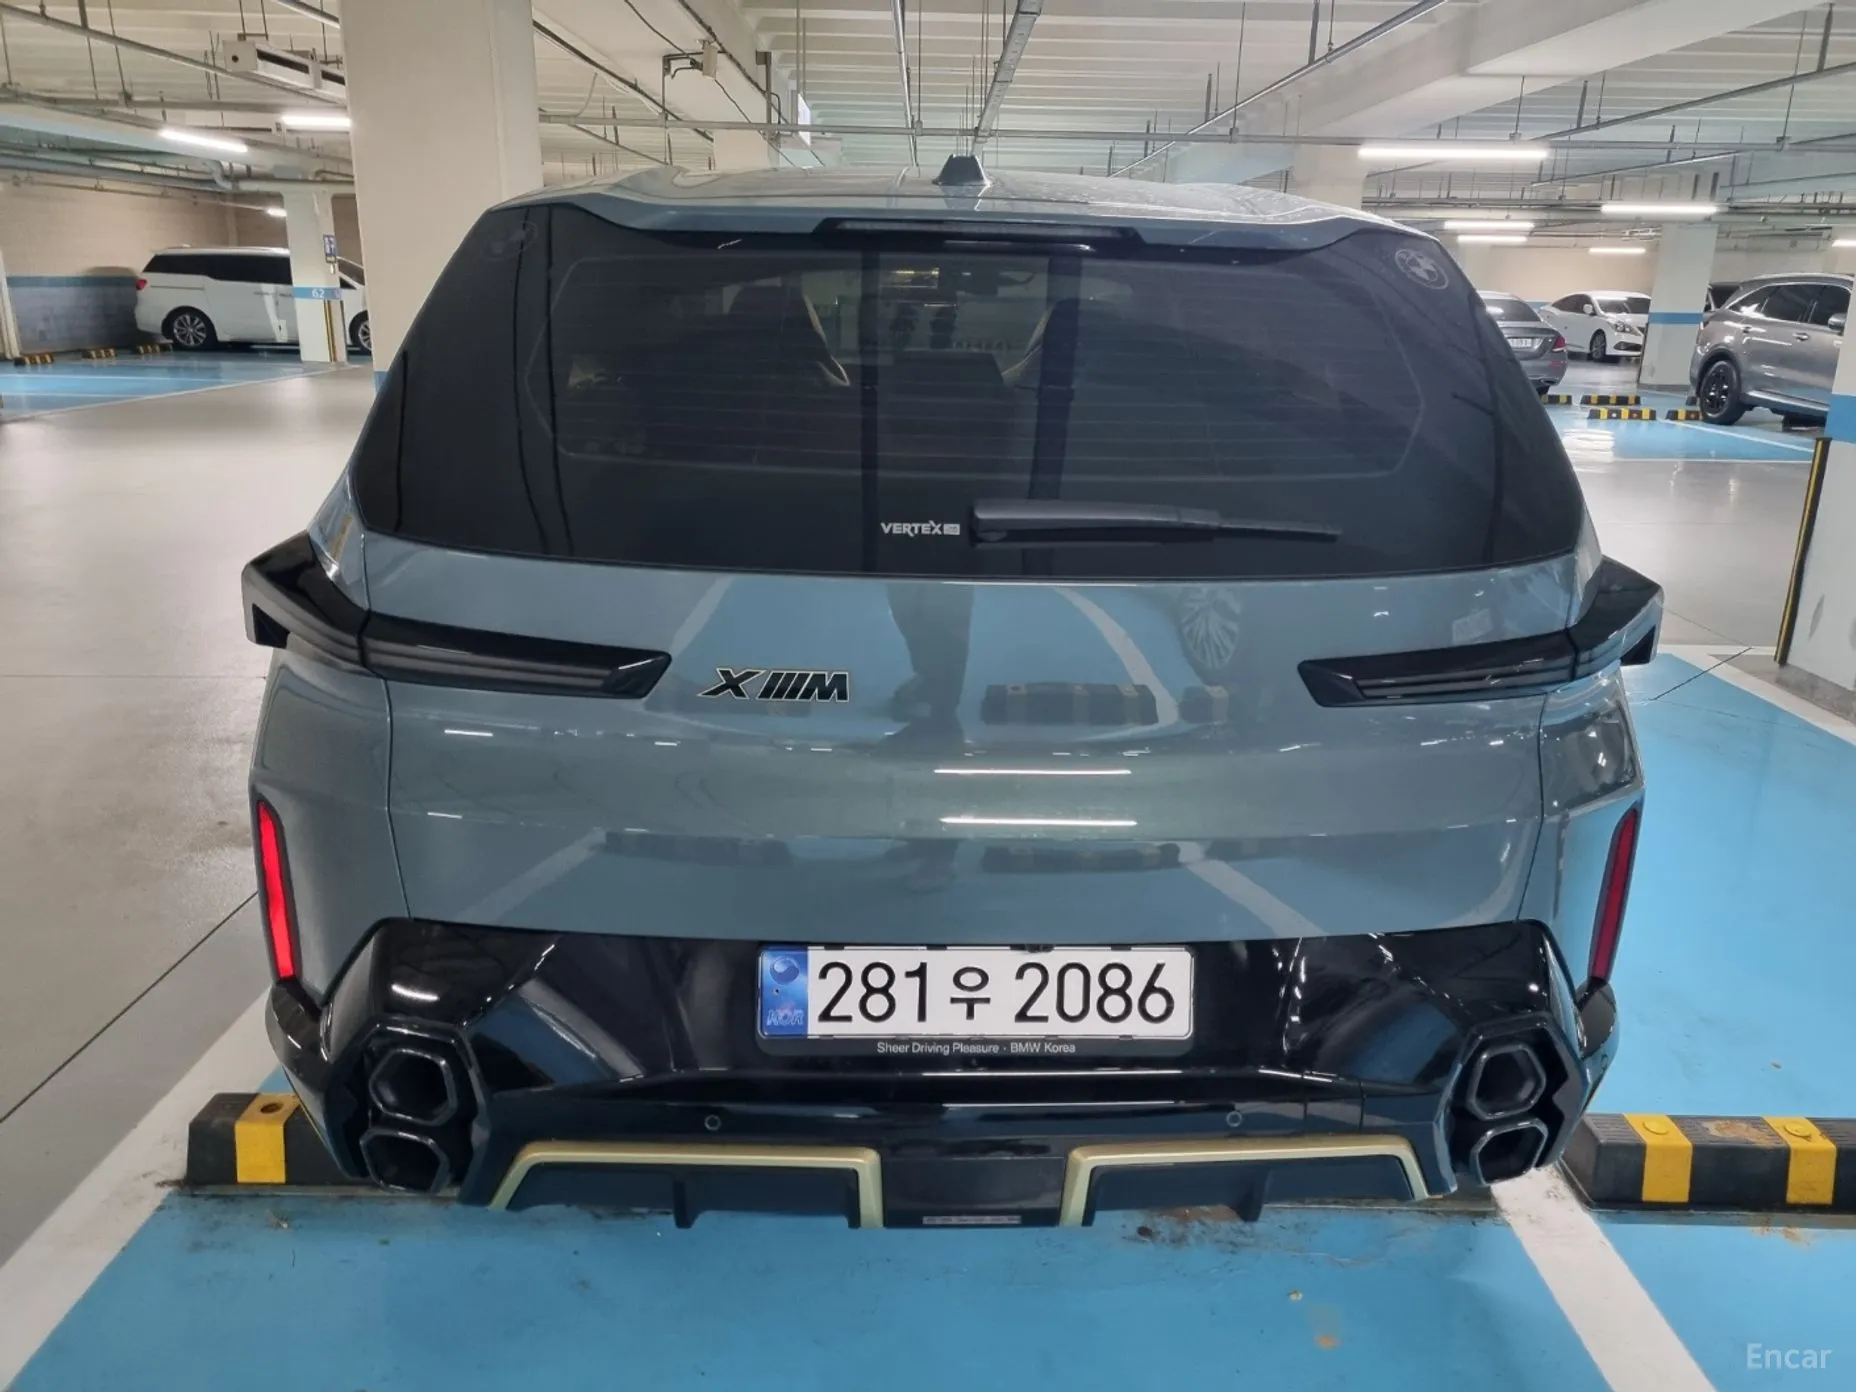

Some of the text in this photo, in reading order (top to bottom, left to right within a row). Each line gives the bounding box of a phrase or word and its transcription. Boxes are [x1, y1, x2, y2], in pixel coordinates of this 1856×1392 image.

[881, 520, 942, 537] VERTEX
[1014, 962, 1175, 1024] 2086
[877, 1042, 1076, 1055] Sheer Driving Pleasure BMW Korea
